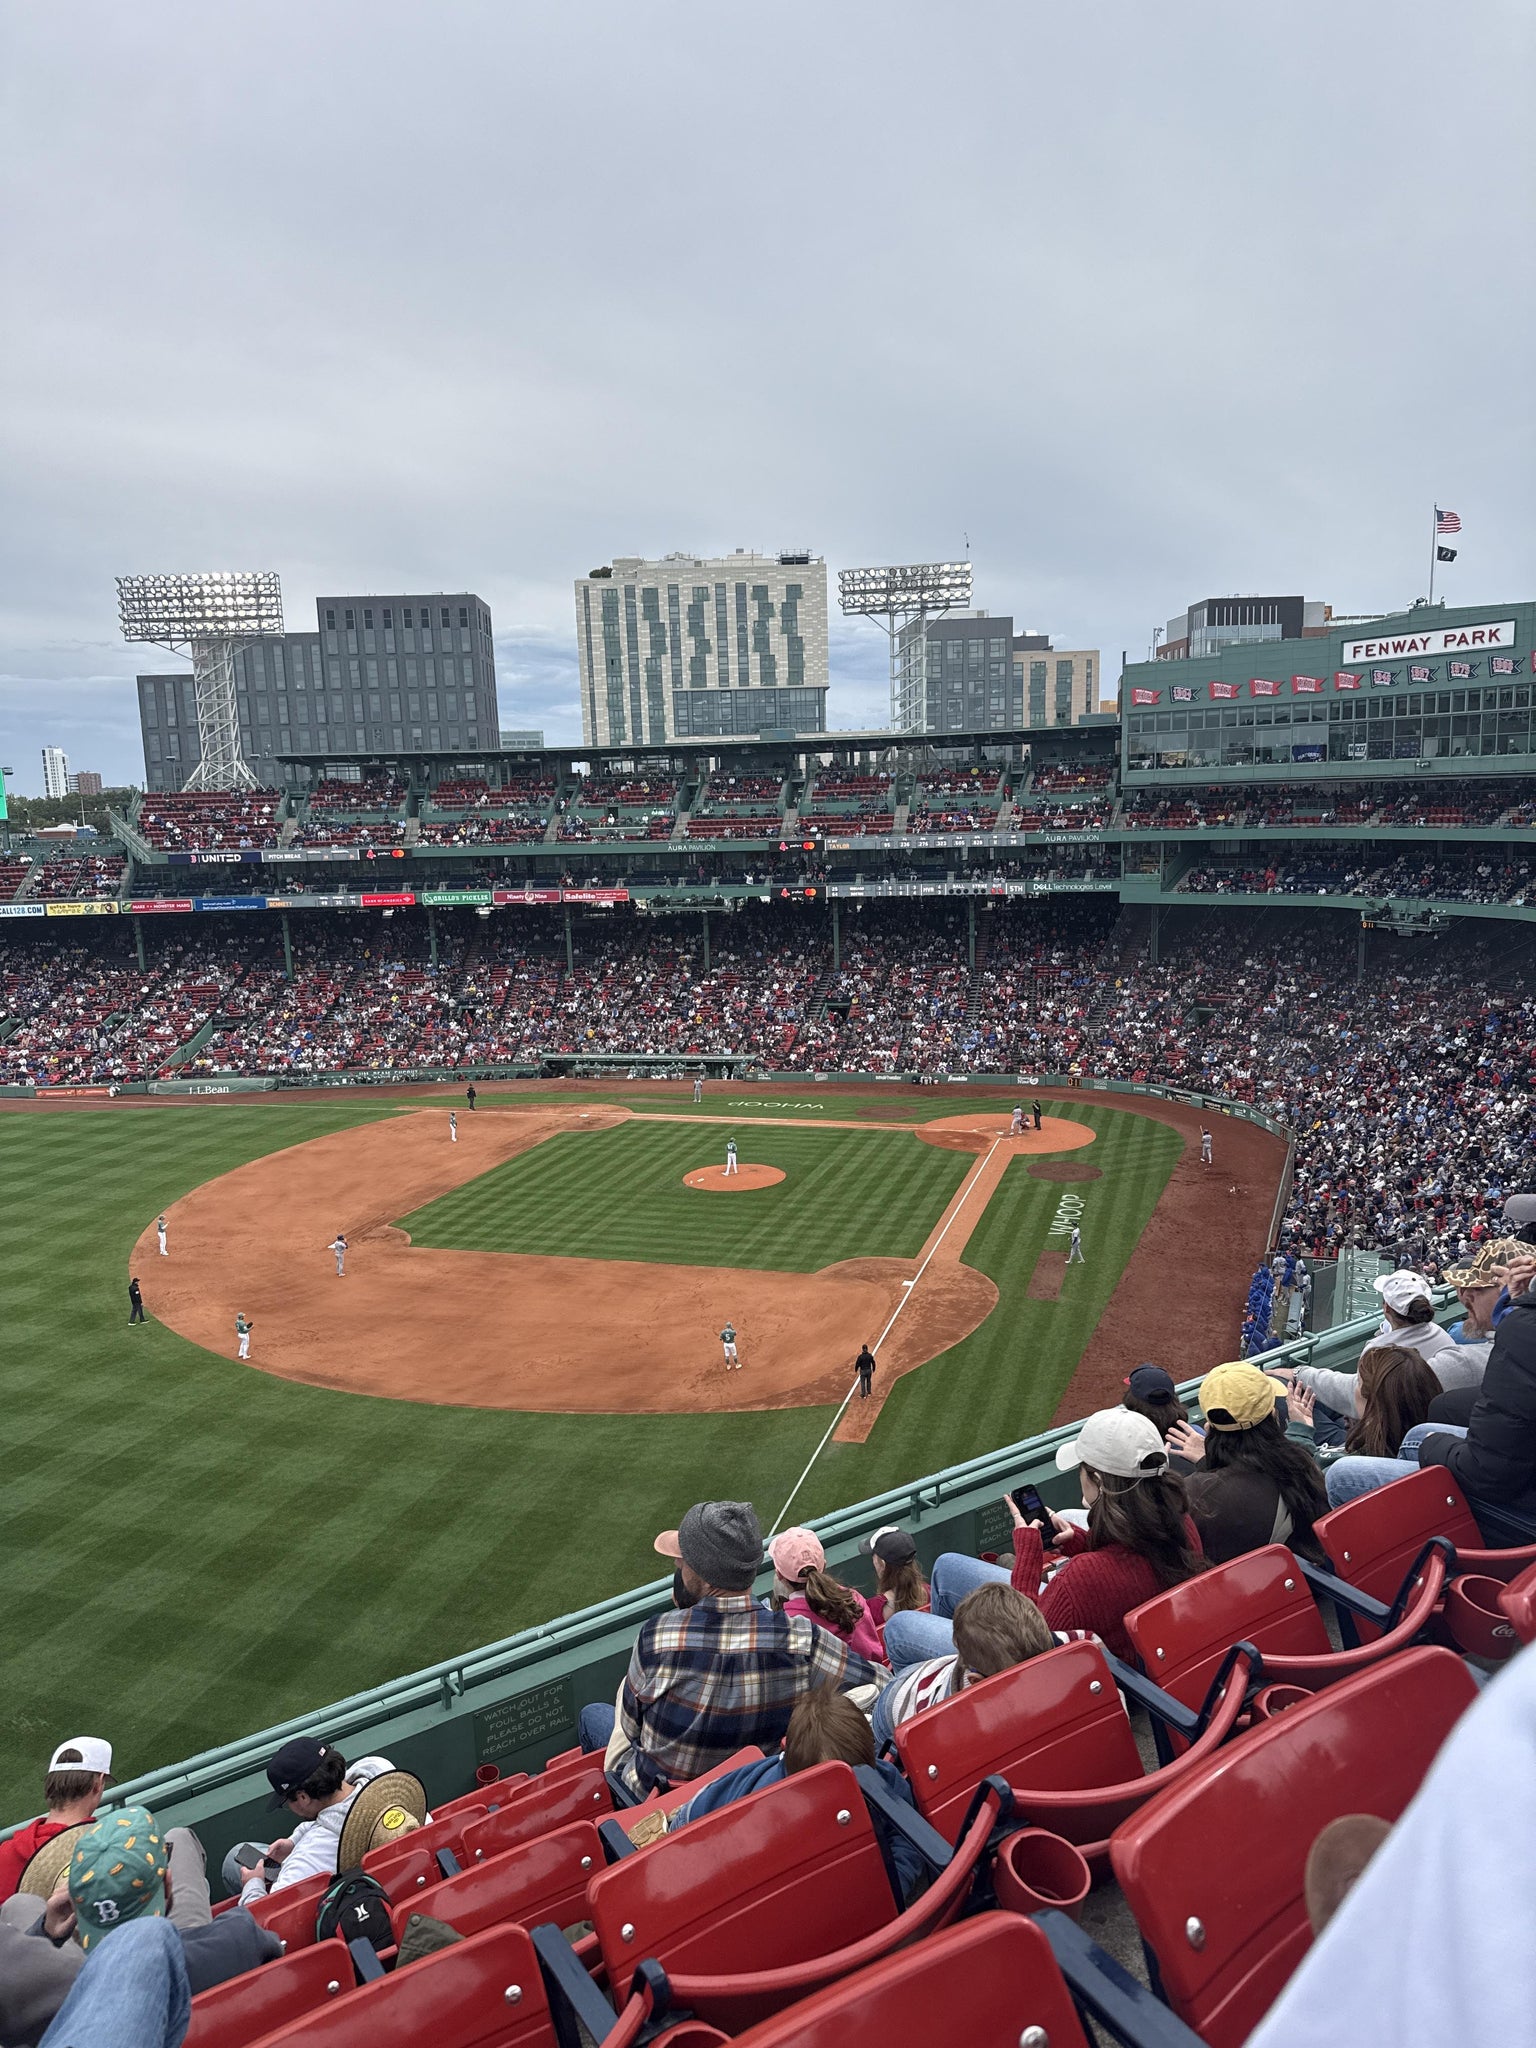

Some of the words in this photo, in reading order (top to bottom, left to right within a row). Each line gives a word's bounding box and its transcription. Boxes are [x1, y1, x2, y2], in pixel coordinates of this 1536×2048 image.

[1352, 636, 1430, 658] FENWAY
[1444, 628, 1500, 648] PARK
[202, 854, 242, 863] UNITED
[728, 1101, 824, 1110] WHOOP
[1048, 1194, 1086, 1235] WHOOP
[981, 1505, 1003, 1517] WATCH
[985, 1515, 1002, 1525] FOUL
[980, 1533, 1002, 1545] REACH
[983, 1522, 1007, 1535] PLEASE
[484, 1704, 516, 1721] WATCH
[520, 1694, 539, 1708] OUT
[544, 1684, 564, 1697] FOR
[487, 1724, 524, 1743] PLEASE
[528, 1716, 542, 1726] DO
[546, 1705, 564, 1719] NOT
[489, 1716, 516, 1731] FOUL
[520, 1702, 549, 1718] BALLS
[482, 1738, 516, 1757] REACH
[520, 1724, 546, 1740] OVER
[550, 1716, 569, 1727] RAIL
[93, 1899, 122, 1924] B
